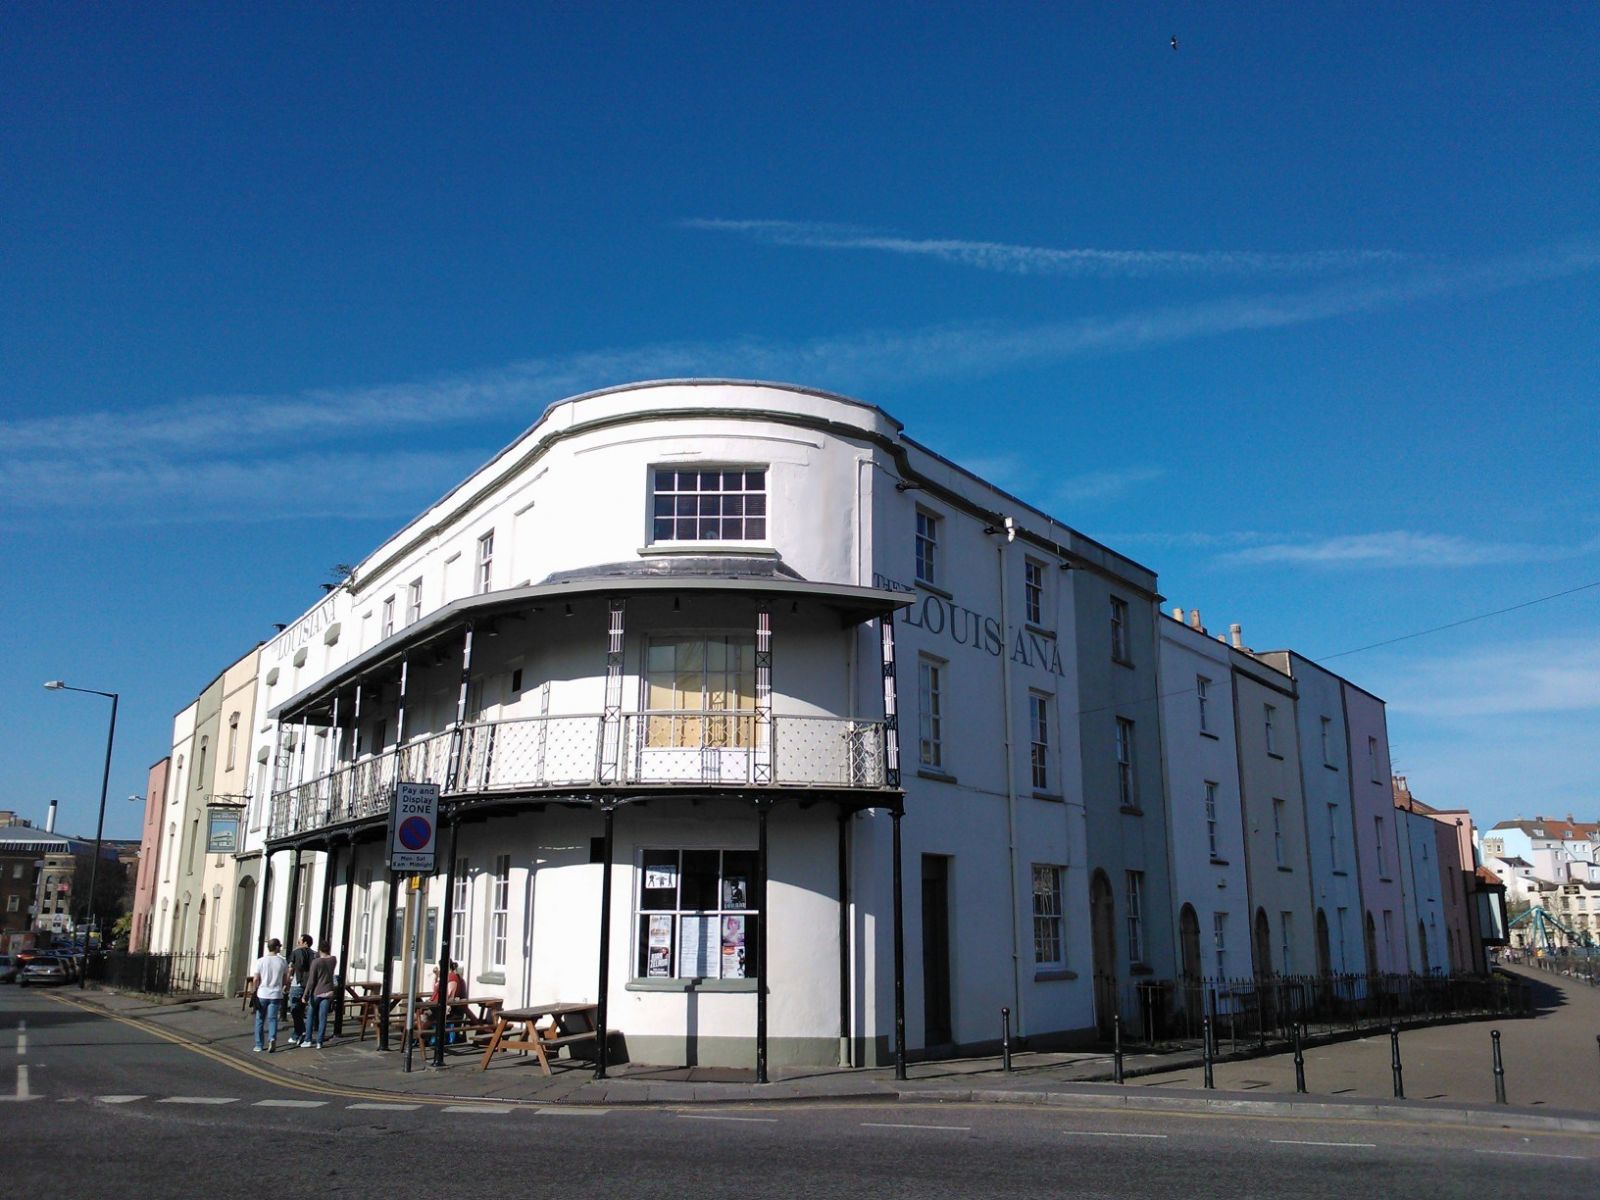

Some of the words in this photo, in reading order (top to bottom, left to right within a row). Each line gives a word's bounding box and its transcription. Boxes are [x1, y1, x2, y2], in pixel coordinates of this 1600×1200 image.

[901, 595, 1066, 677] LOUISANA
[402, 786, 417, 795] Pay
[402, 795, 433, 804] Display
[402, 804, 431, 813] ZONE
